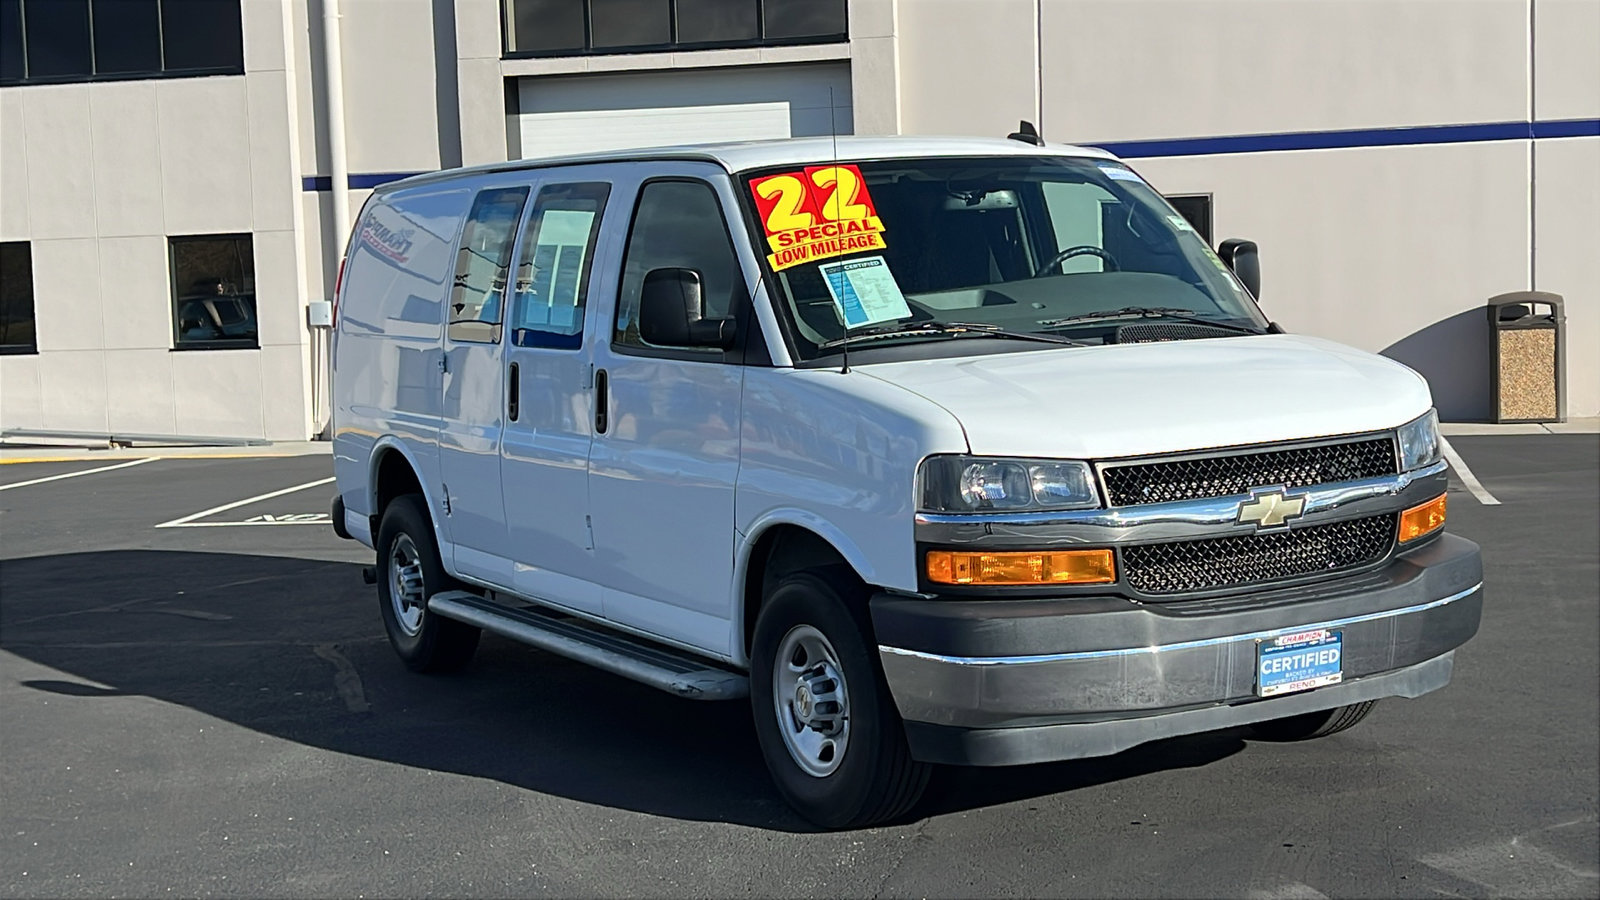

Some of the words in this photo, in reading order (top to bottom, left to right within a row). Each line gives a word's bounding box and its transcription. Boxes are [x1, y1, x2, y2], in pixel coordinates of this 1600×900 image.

[756, 167, 871, 233] 22
[777, 219, 877, 247] SPECIAL
[774, 245, 810, 267] LOW
[811, 234, 878, 257] MILEAGE
[843, 260, 881, 271] CERTIFIED
[1282, 631, 1322, 644] CHAMPION
[1261, 649, 1339, 674] CERTIFIED
[1290, 680, 1315, 689] RENO
